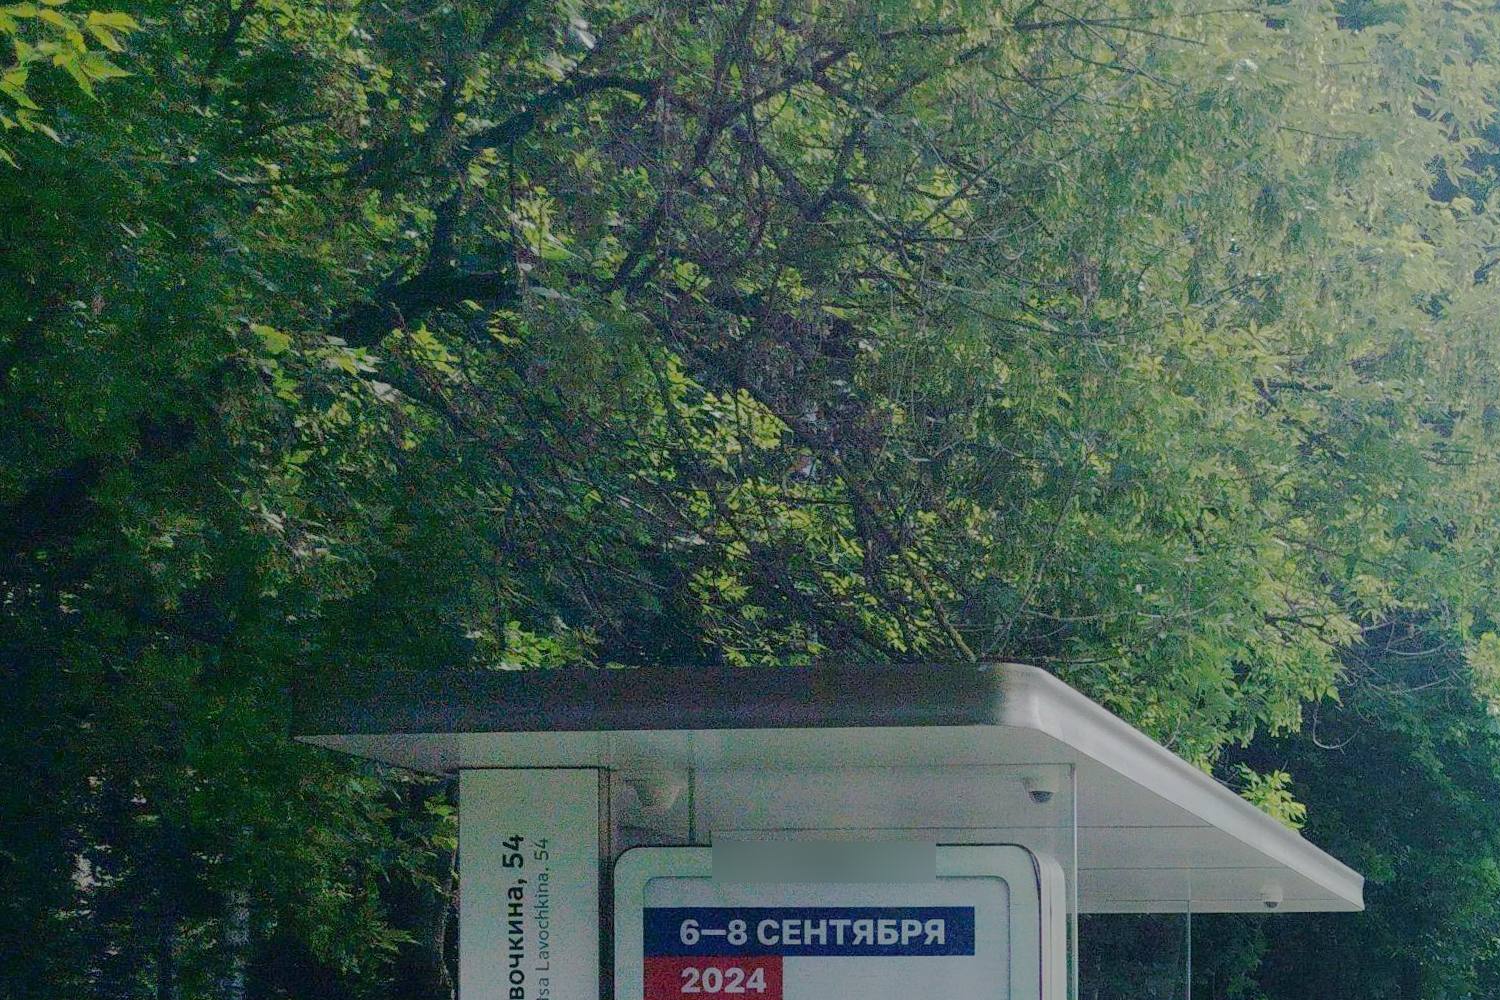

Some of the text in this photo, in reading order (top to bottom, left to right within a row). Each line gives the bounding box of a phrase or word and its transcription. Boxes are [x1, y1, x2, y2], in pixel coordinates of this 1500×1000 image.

[502, 834, 524, 869] 54
[534, 838, 549, 861] 54
[757, 918, 946, 946] СЕНТЯБРЯ
[680, 966, 767, 994] 2024
